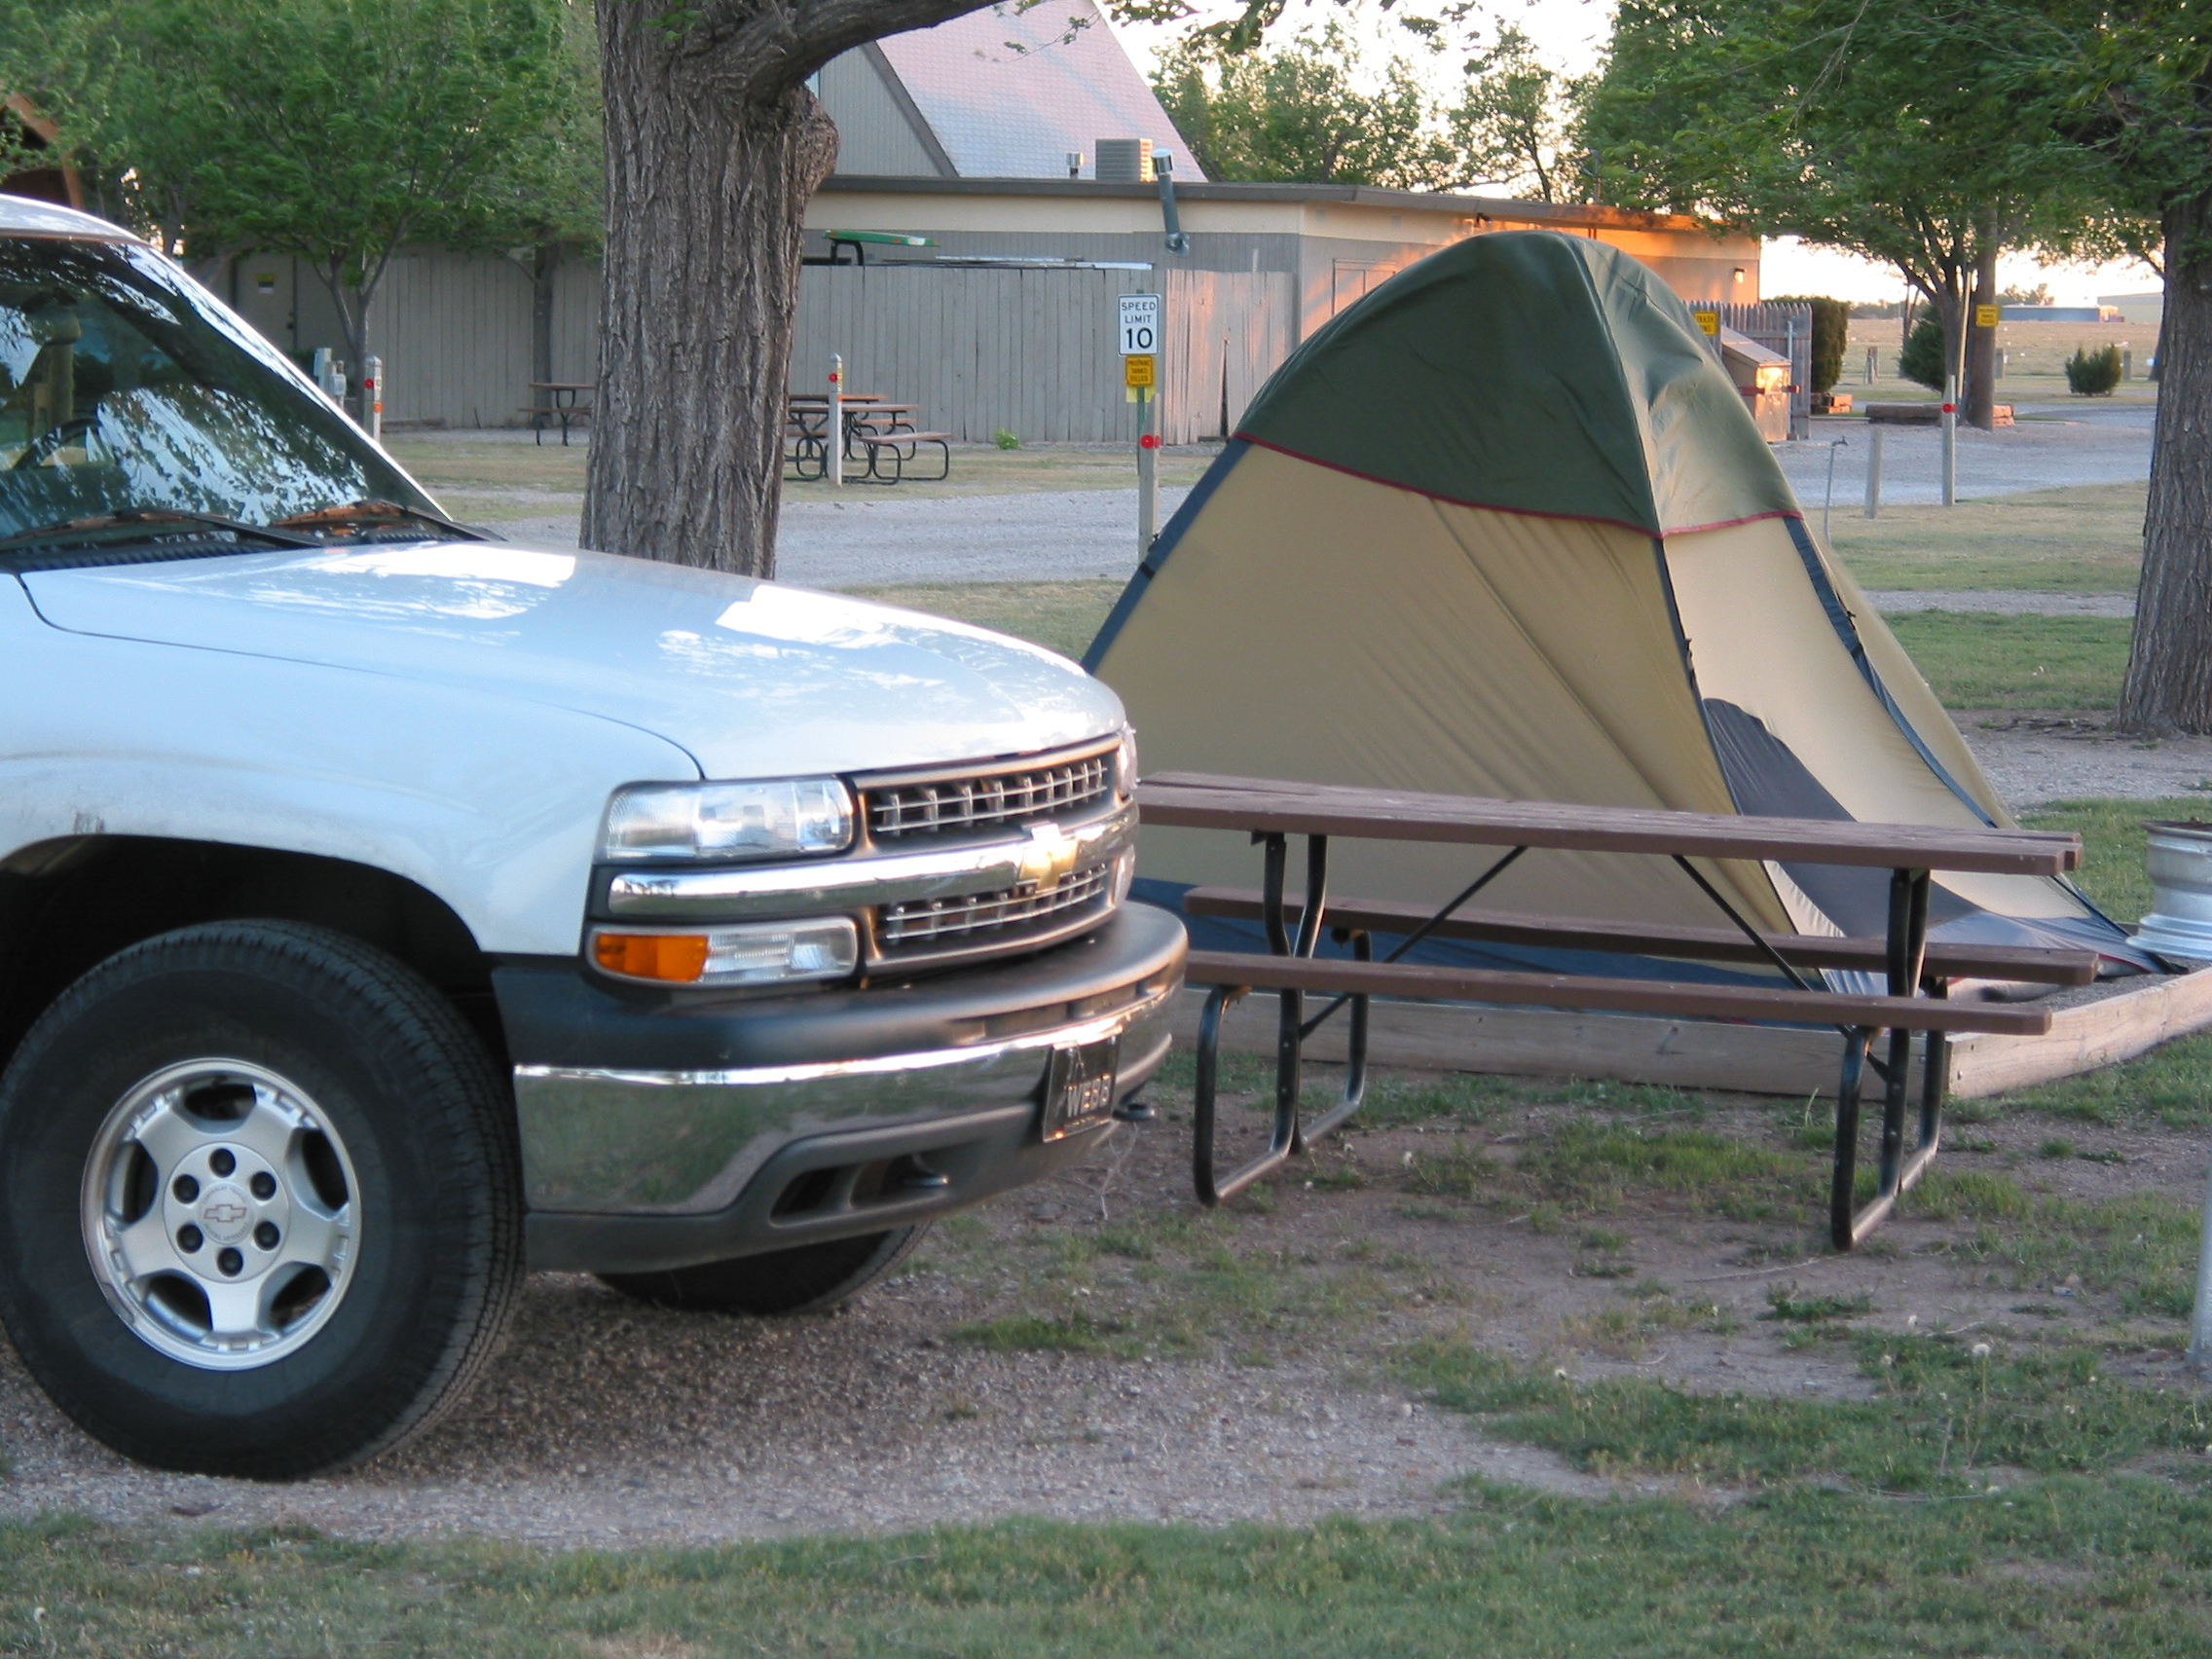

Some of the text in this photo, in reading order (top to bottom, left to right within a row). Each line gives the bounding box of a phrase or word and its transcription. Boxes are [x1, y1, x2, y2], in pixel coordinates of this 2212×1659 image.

[1121, 301, 1157, 312] SPEED
[1124, 314, 1152, 323] LIMIT
[1125, 327, 1153, 350] 10
